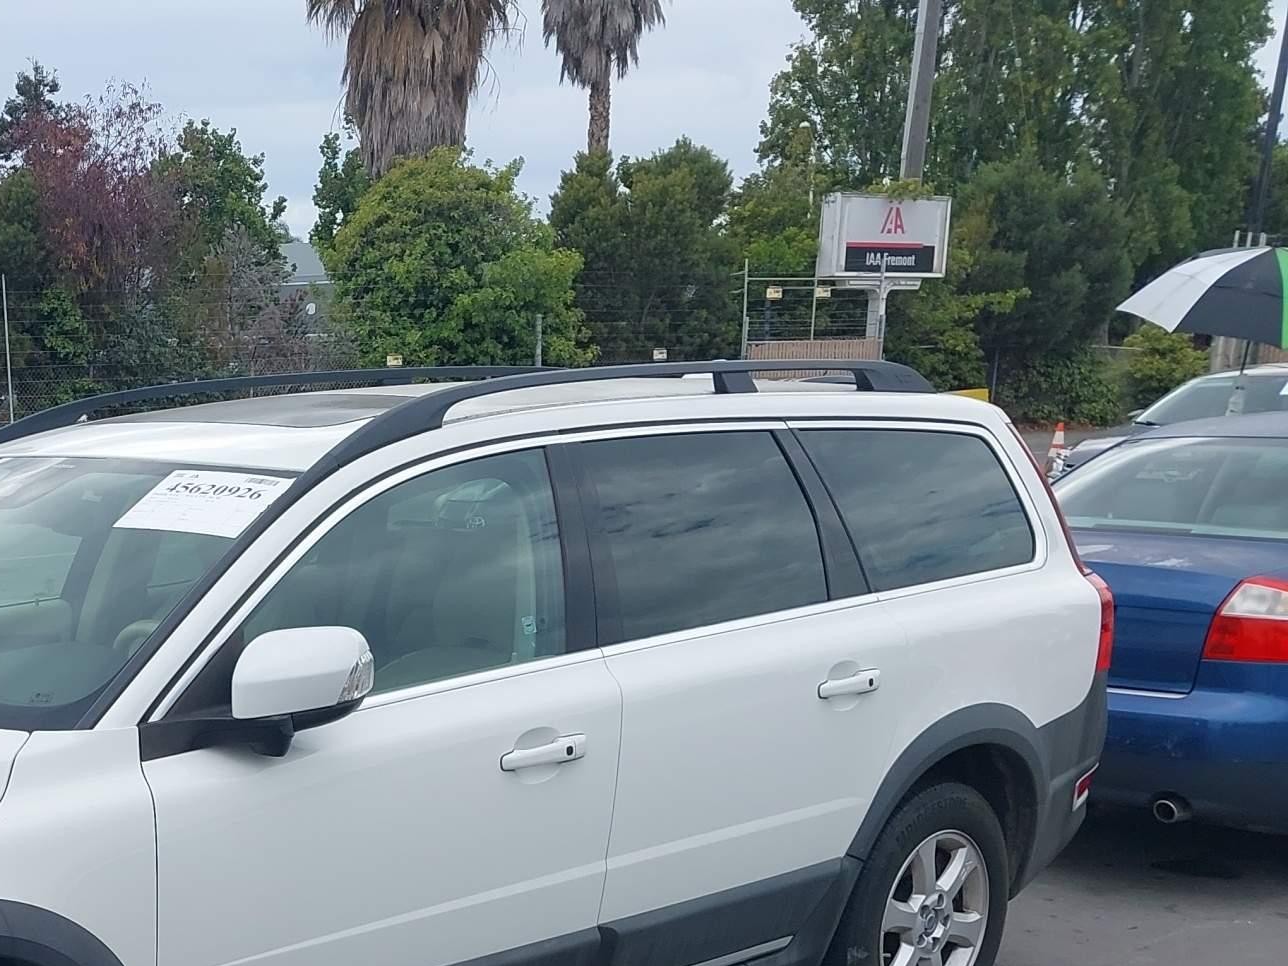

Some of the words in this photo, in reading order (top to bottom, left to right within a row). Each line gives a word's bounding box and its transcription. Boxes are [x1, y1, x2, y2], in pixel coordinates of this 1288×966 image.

[865, 251, 882, 266] IAA
[884, 252, 916, 267] Fremont
[166, 481, 268, 501] 45620926
